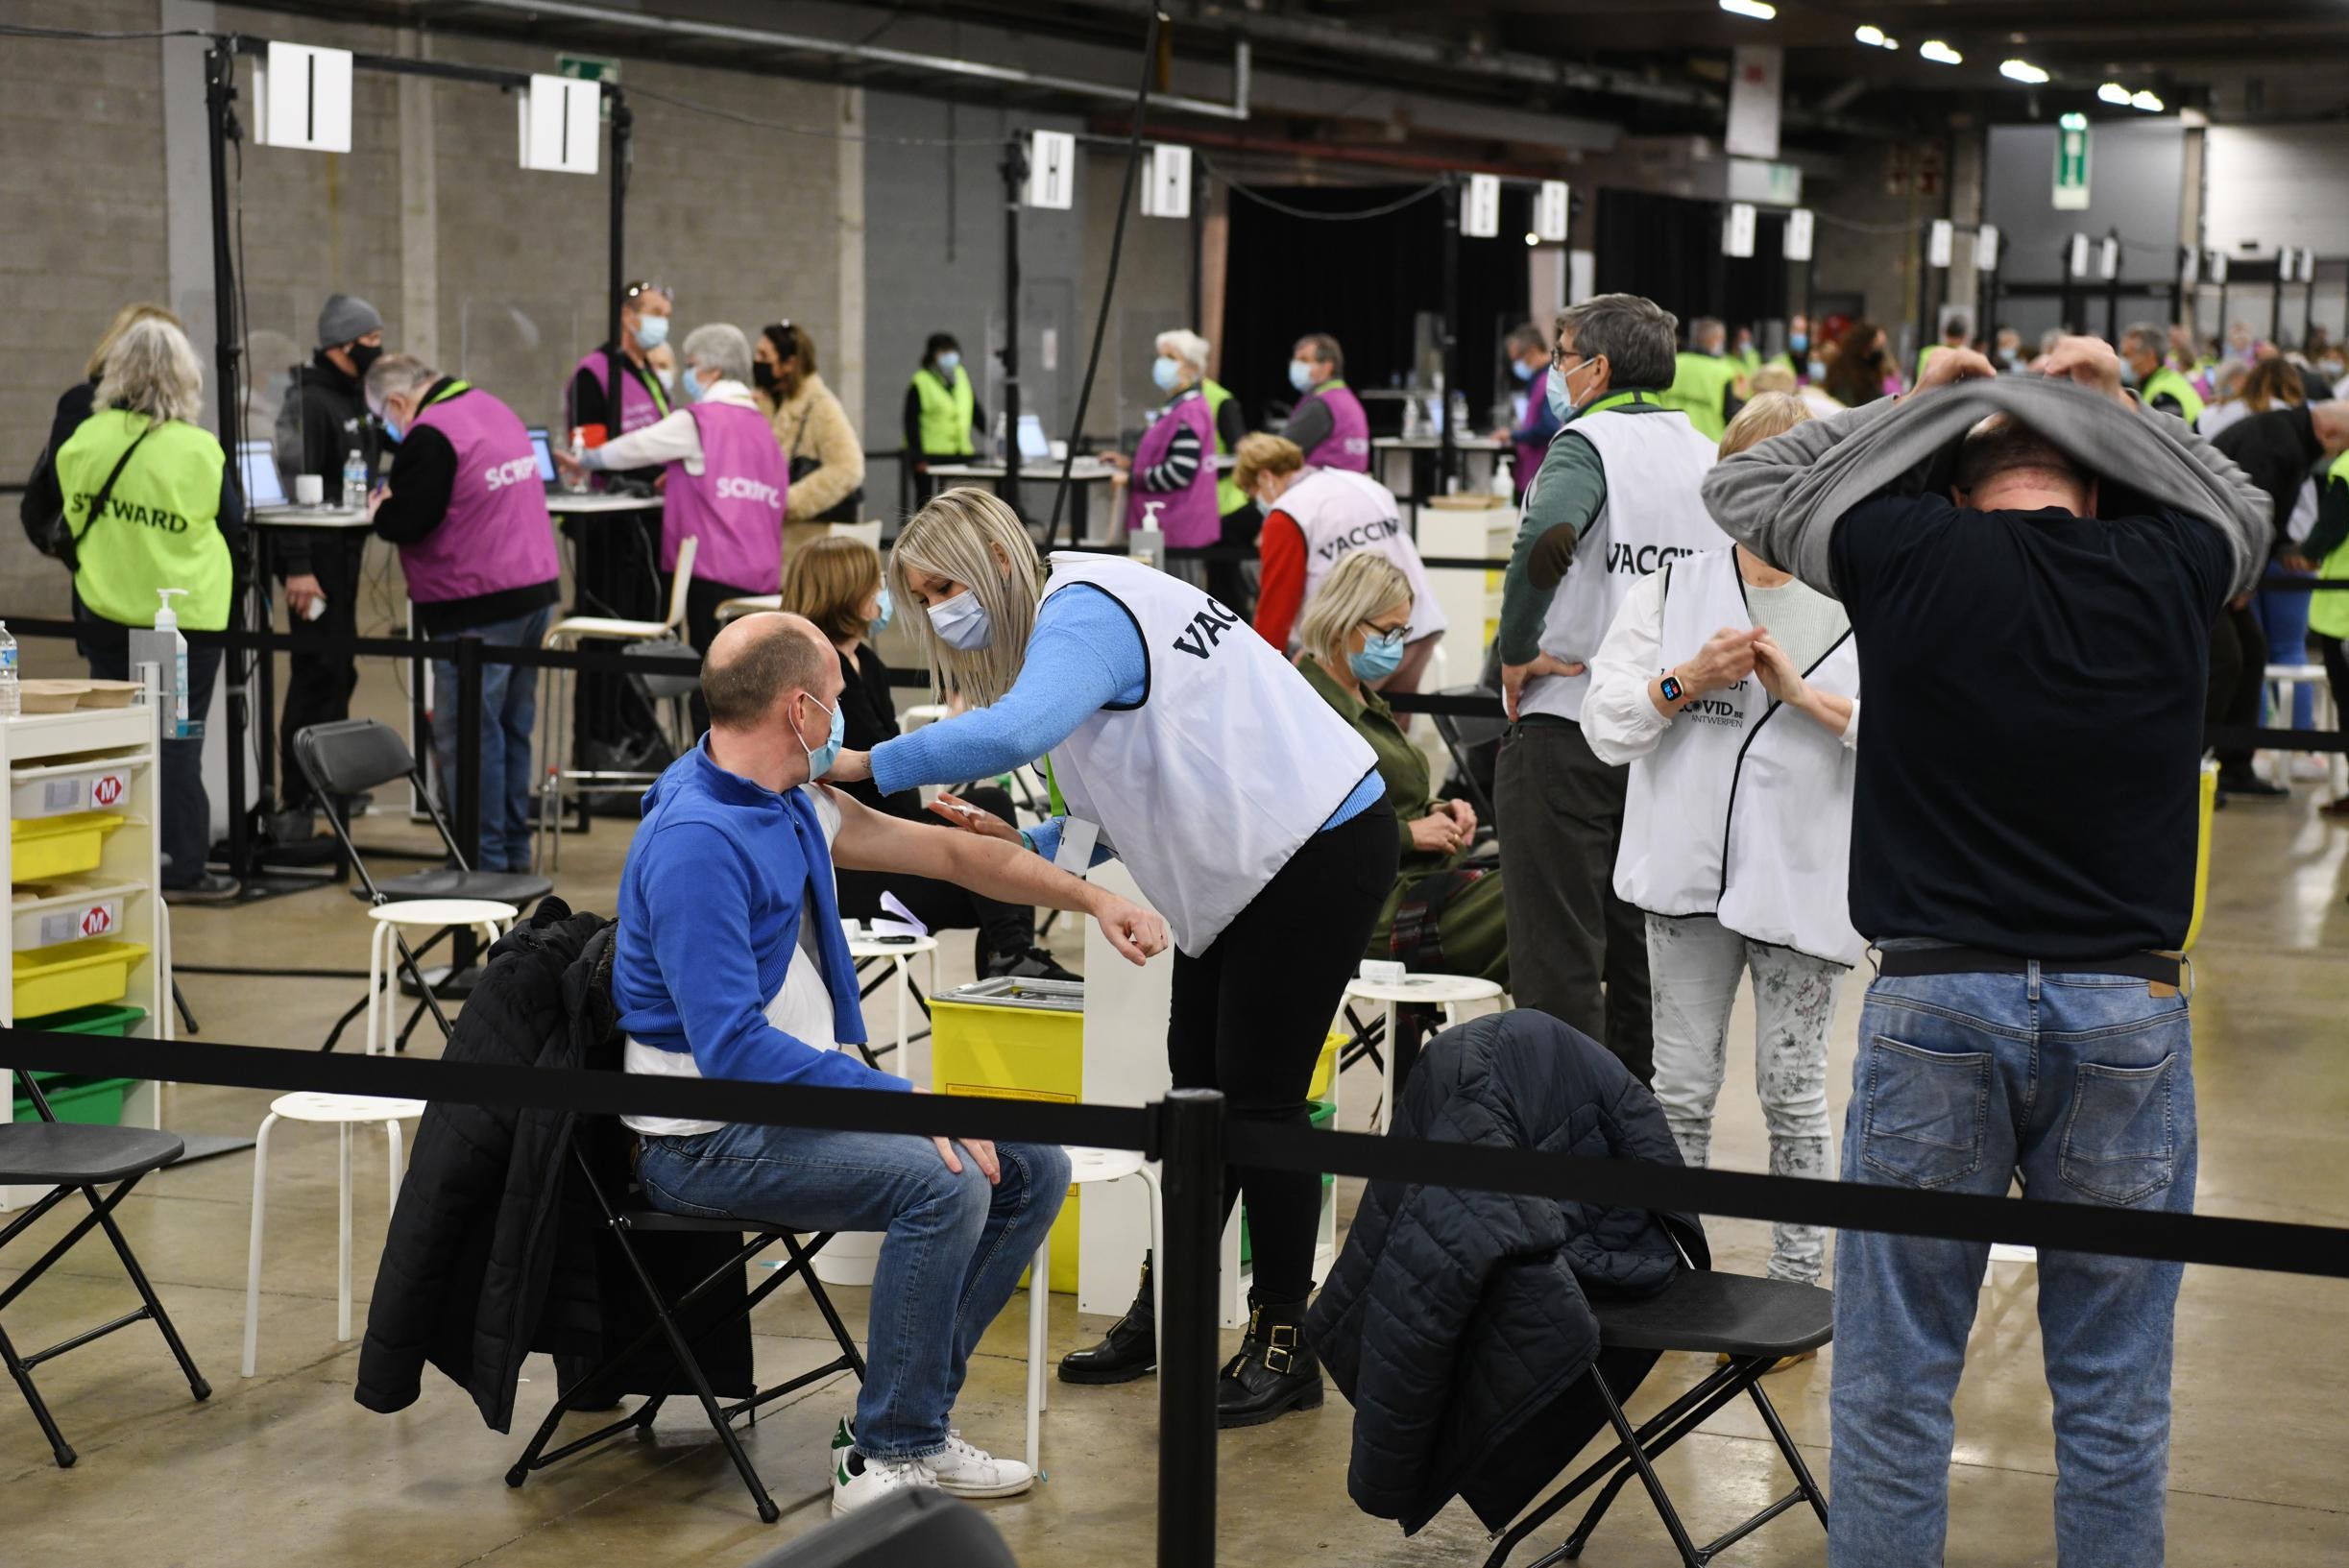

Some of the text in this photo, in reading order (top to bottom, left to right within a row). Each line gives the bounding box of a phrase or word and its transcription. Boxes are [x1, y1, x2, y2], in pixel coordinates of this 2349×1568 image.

[1691, 713, 1743, 730] ANTWERPEN
[101, 780, 117, 803] M
[88, 912, 104, 934] M
